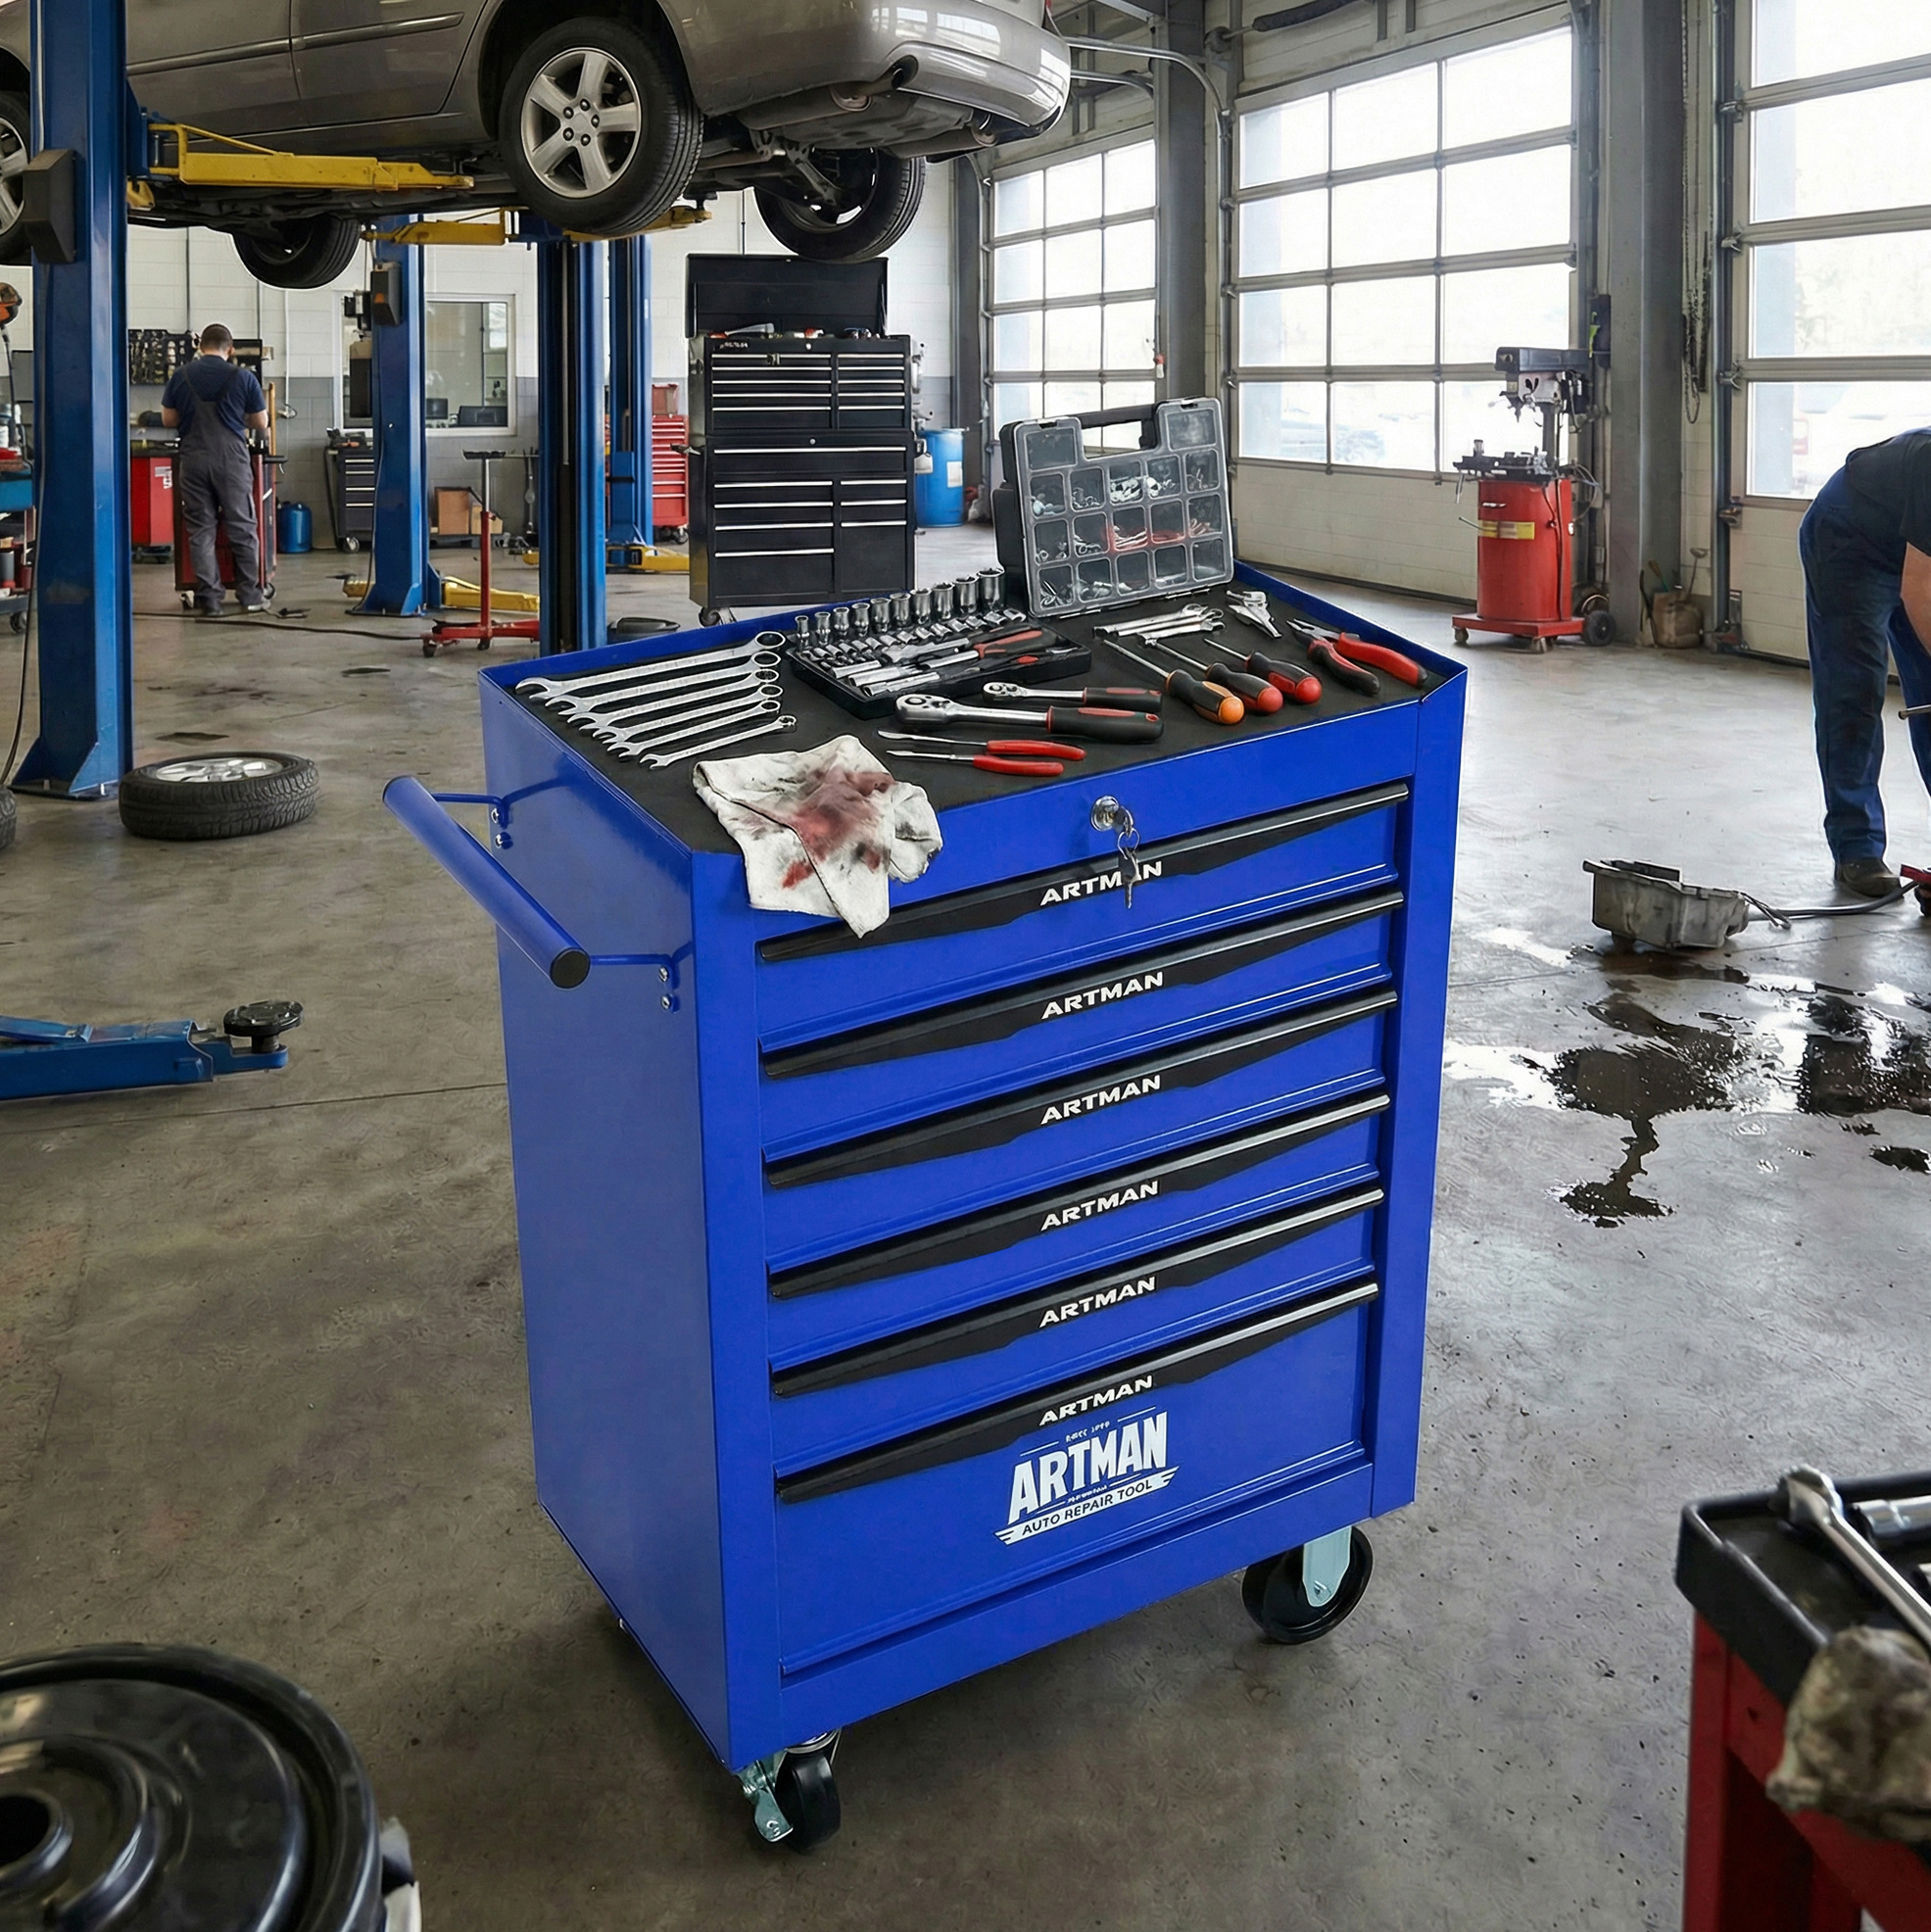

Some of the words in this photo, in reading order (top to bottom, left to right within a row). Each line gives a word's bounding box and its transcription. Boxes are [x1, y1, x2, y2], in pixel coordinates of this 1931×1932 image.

[1039, 860, 1162, 906] ARTMN
[1040, 971, 1163, 1020] ARTMAN
[1040, 1074, 1161, 1125] ARTMAN
[1040, 1180, 1158, 1232] ARTMAN
[1039, 1276, 1155, 1328] ARTMAN
[1038, 1375, 1153, 1426] ARTMAN
[1007, 1411, 1168, 1525] ARTMAN
[1022, 1515, 1060, 1535] AUTO
[1064, 1494, 1114, 1520] REPAIR
[1117, 1479, 1153, 1500] TOOL
